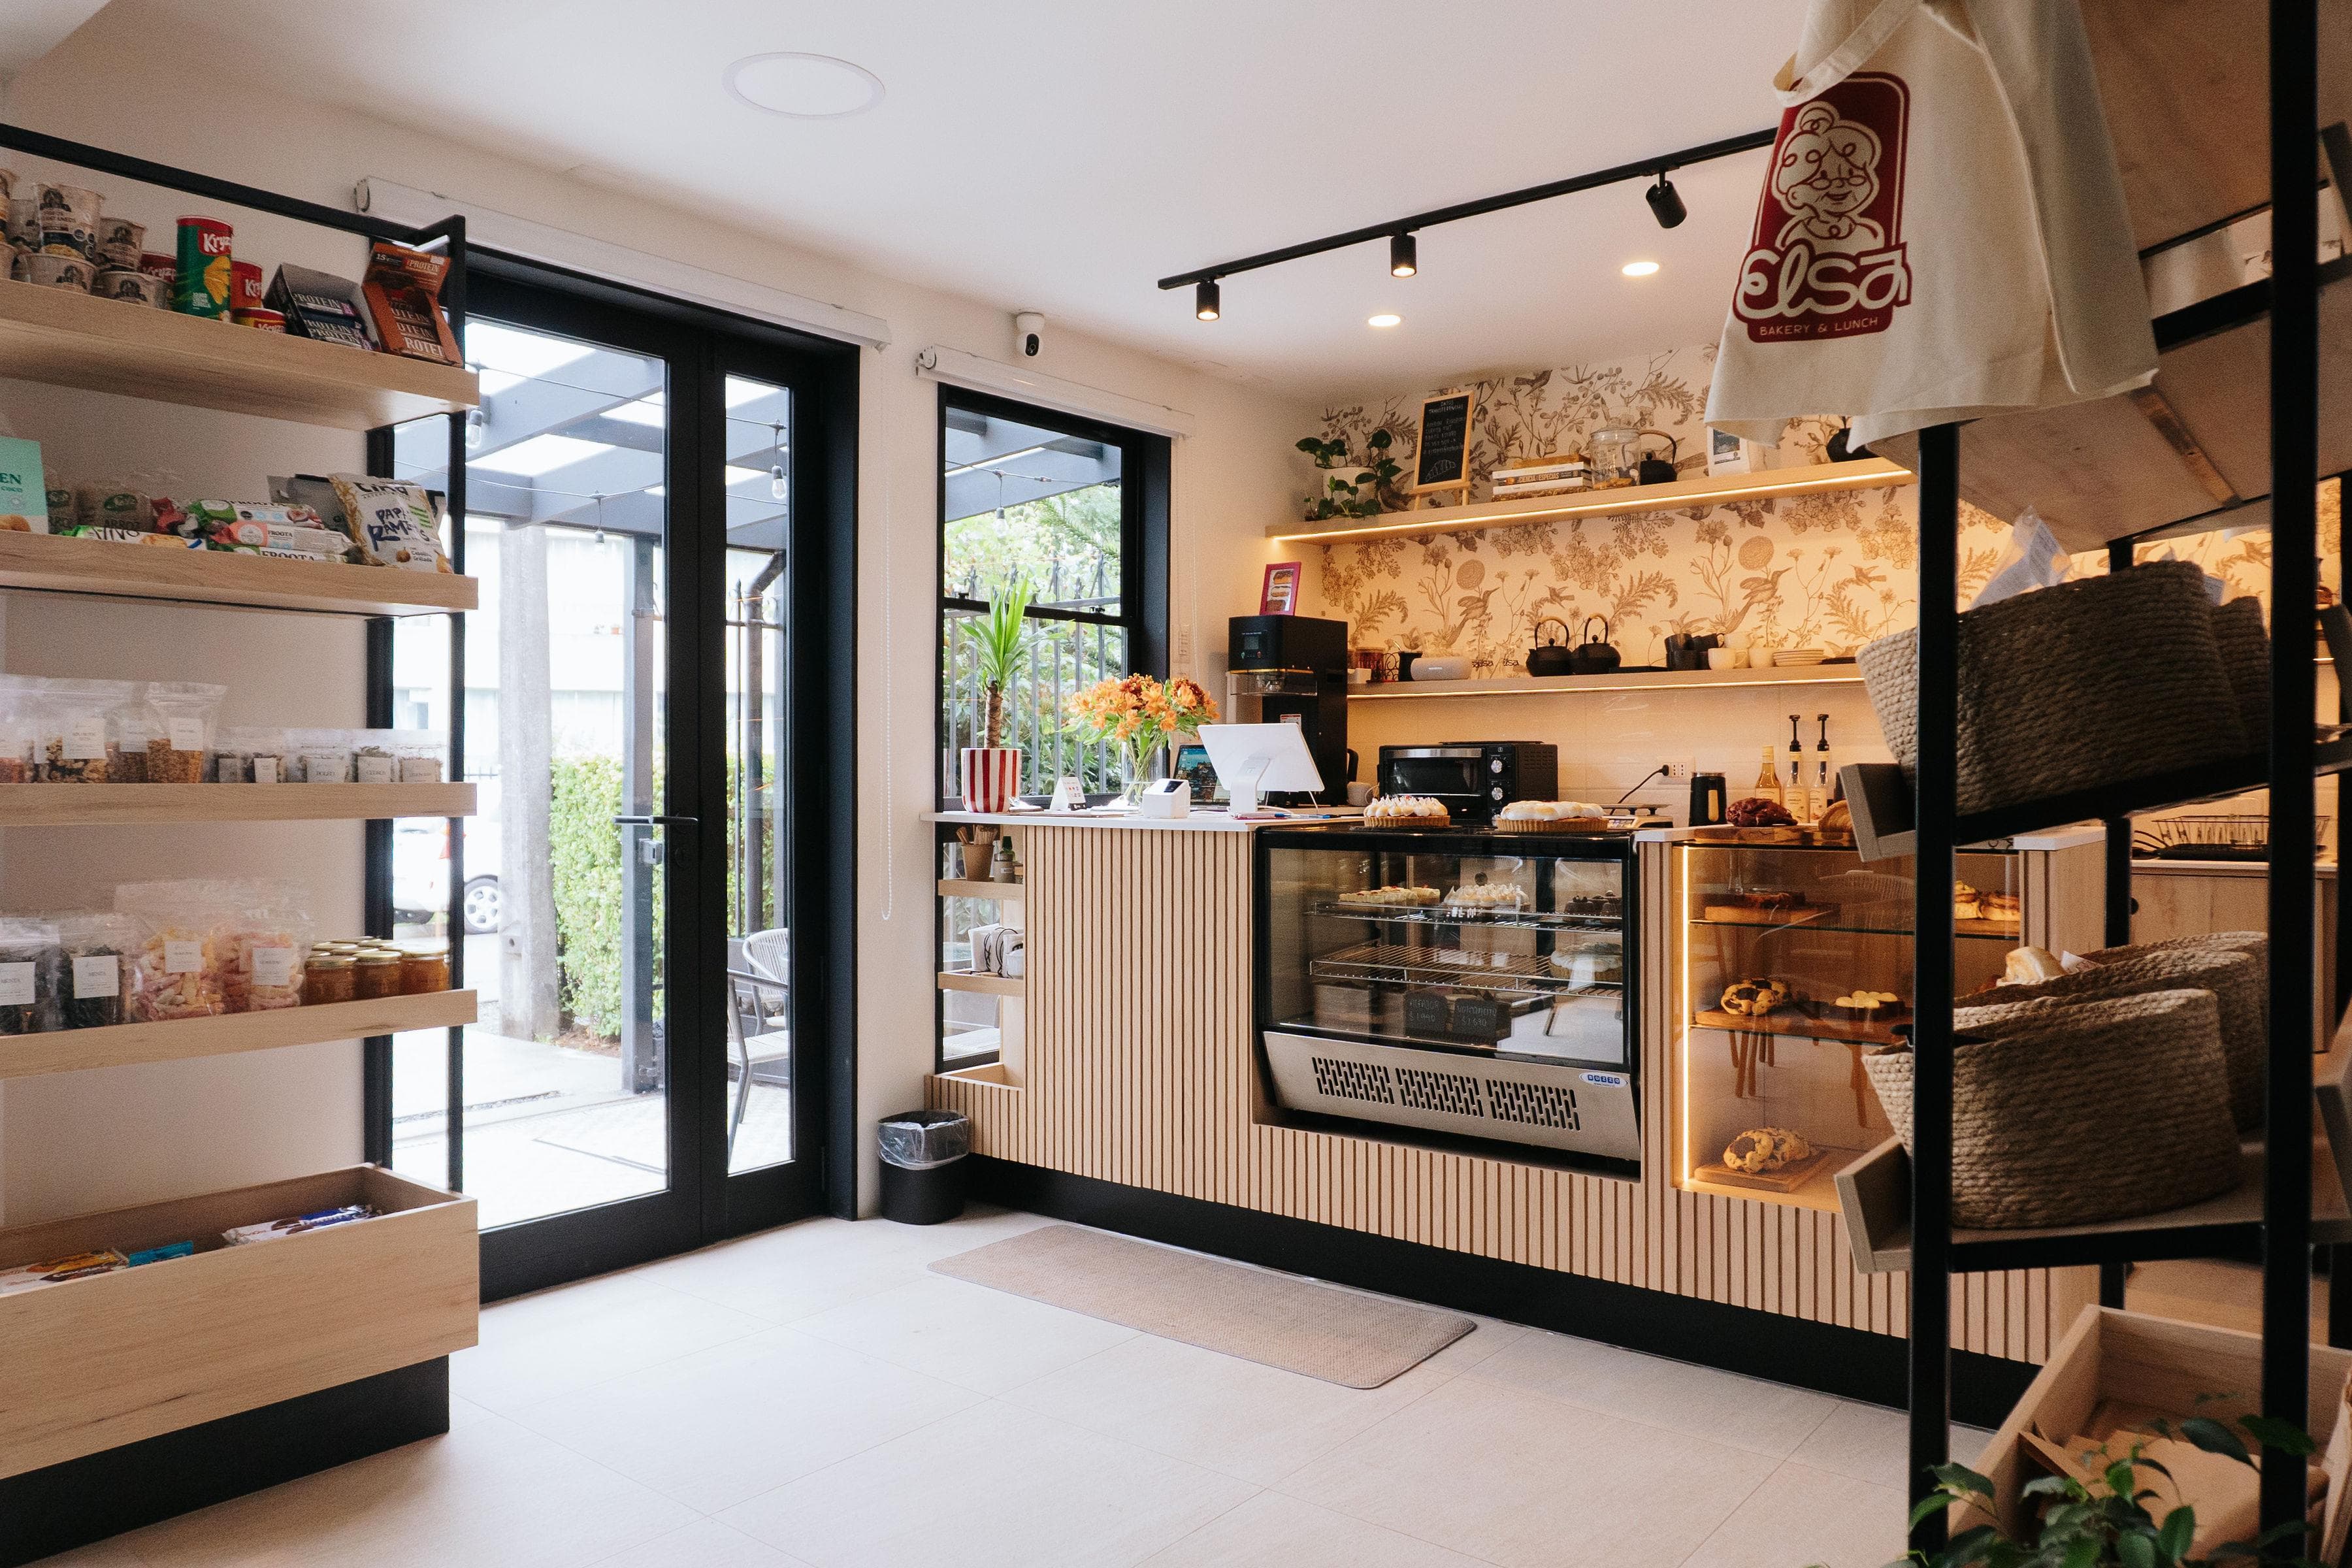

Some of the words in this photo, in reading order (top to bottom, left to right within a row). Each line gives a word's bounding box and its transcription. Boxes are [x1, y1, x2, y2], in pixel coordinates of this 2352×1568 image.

[1736, 244, 1908, 319] Elsa
[1759, 323, 1810, 336] BAKERY
[1818, 321, 1828, 333] &
[1834, 316, 1878, 332] LUNCH
[404, 337, 444, 357] ROTEI
[1587, 1074, 1620, 1085] BOZZO
